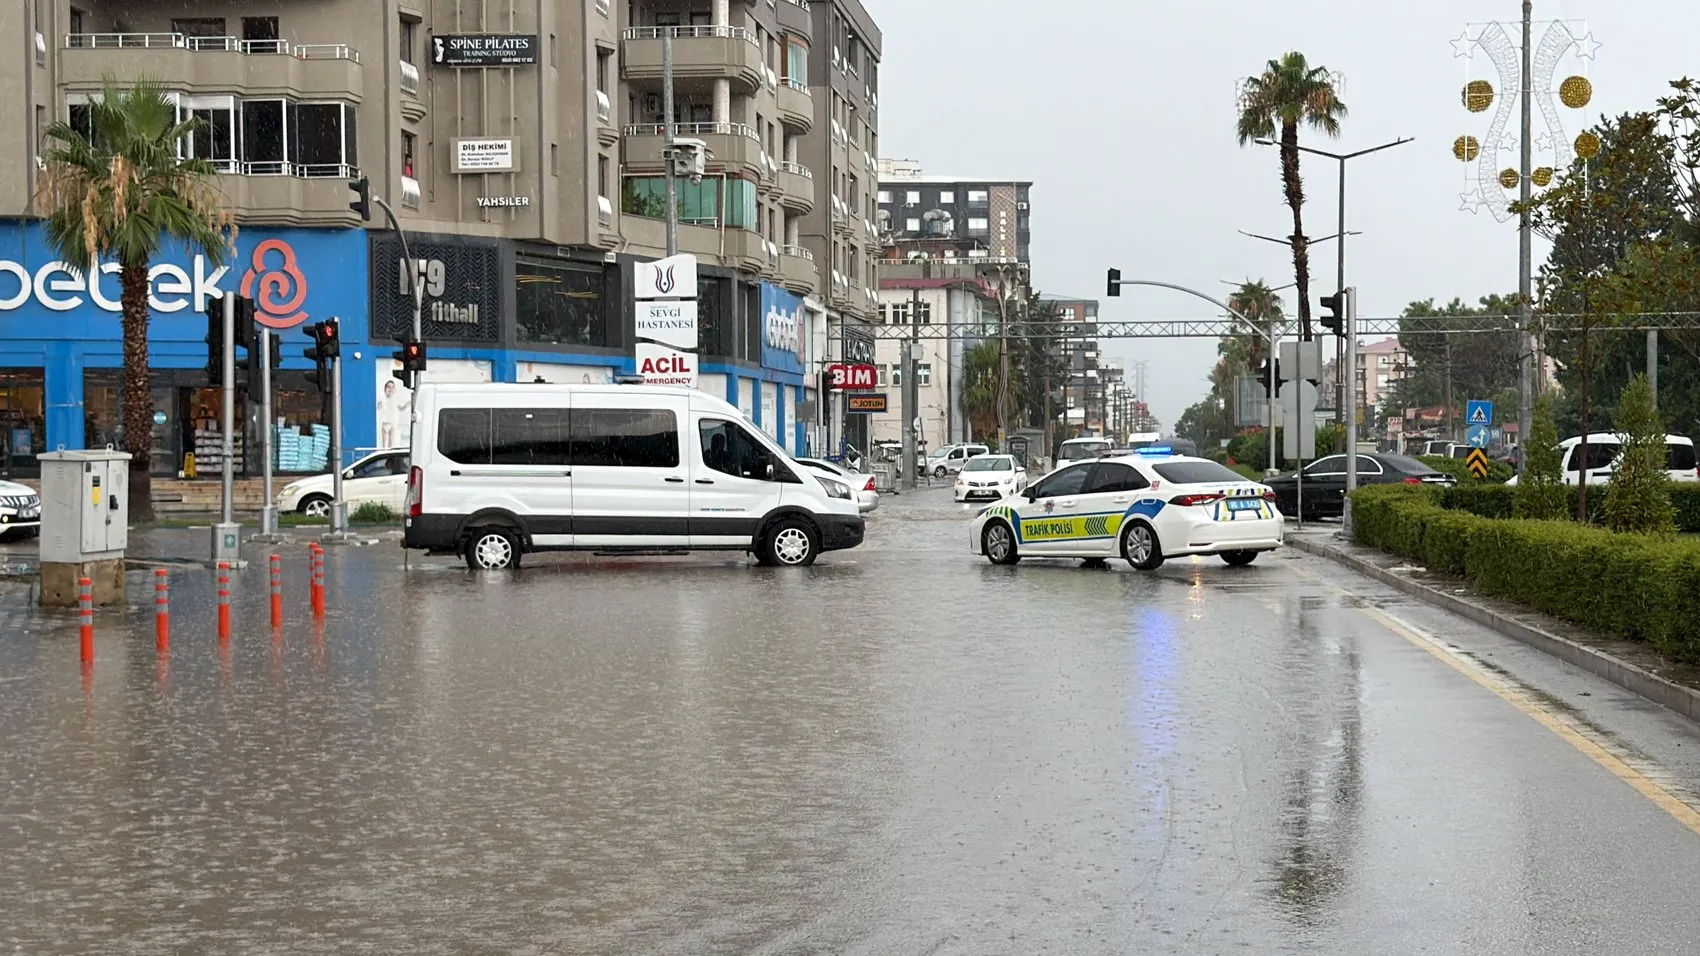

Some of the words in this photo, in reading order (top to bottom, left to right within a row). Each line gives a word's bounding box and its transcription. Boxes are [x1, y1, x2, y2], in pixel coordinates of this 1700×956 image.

[650, 308, 681, 318] SEVGİ
[638, 318, 694, 329] HASTANESİ
[641, 353, 691, 374] ACİL
[859, 397, 883, 408] JOTUN
[1025, 521, 1050, 537] TRAFİK
[1050, 520, 1073, 535] POLİSİ
